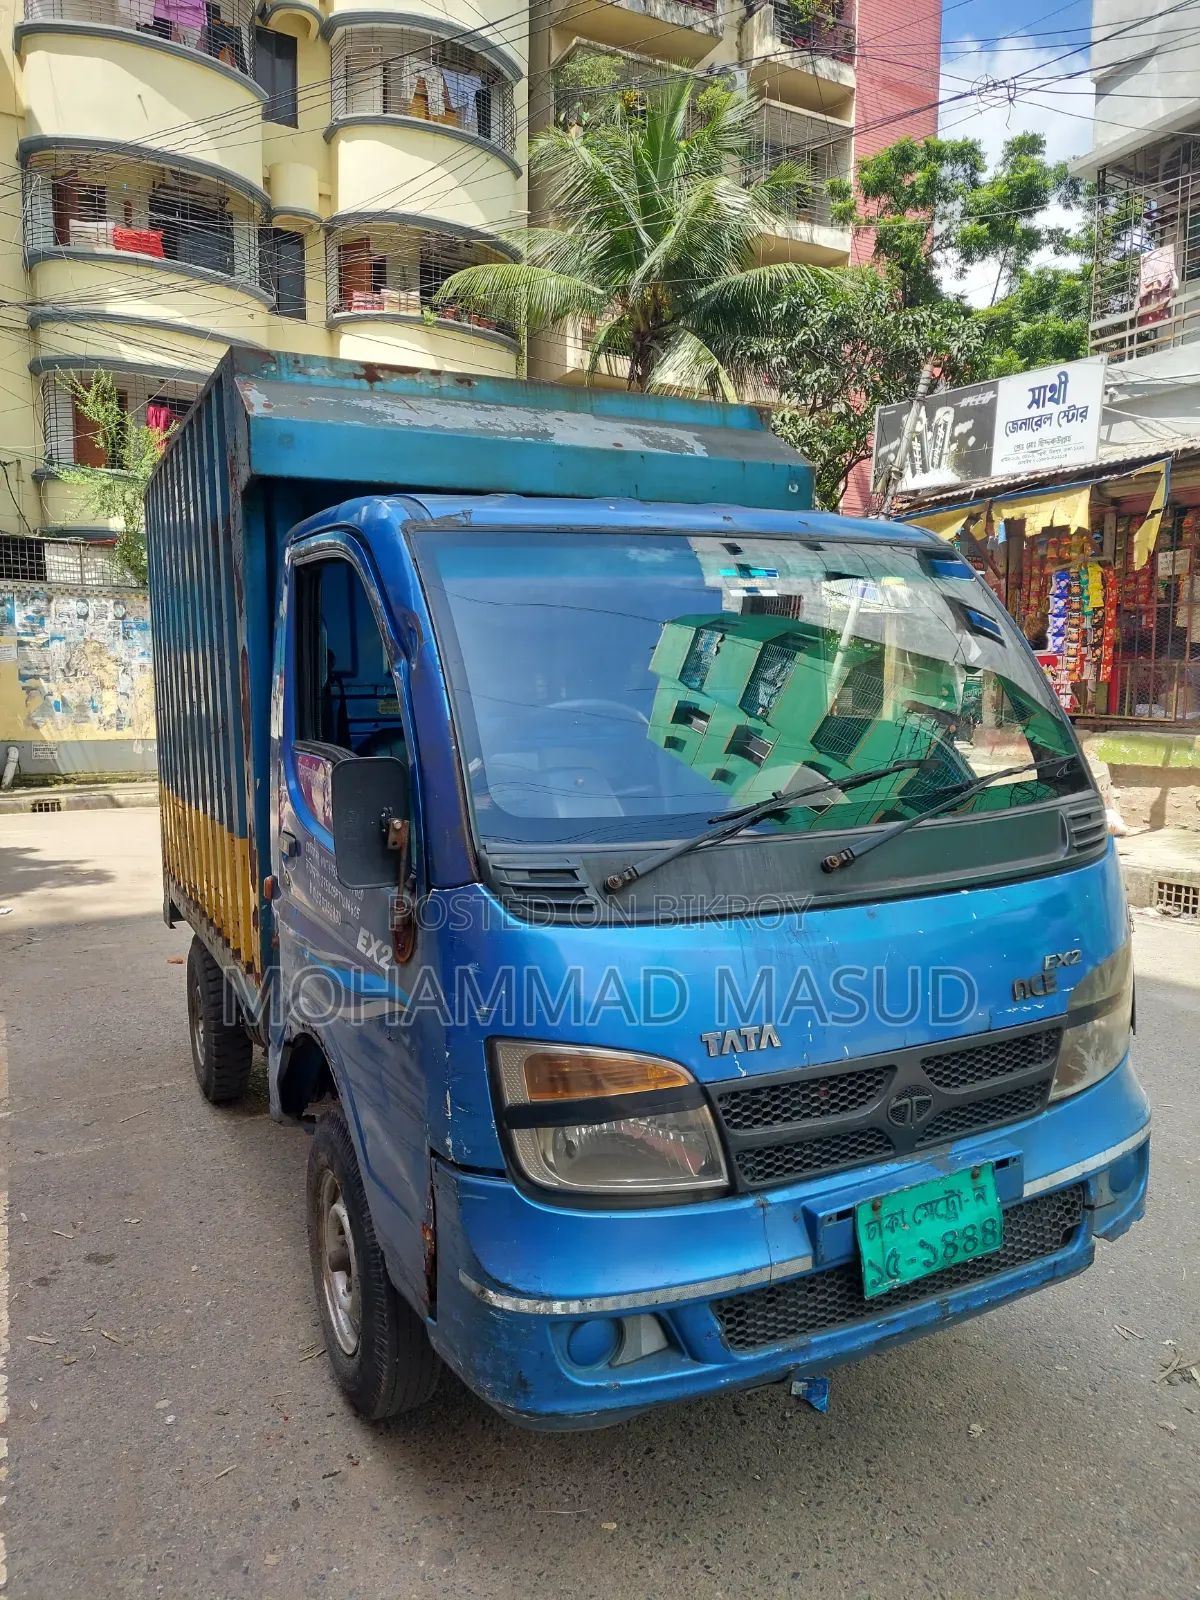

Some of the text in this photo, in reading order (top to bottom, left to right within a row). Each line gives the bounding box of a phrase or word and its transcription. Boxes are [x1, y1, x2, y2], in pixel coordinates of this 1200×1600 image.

[1027, 371, 1069, 409] সাথী
[1005, 404, 1089, 437] জেনারেল স্টোর
[356, 927, 393, 971] EX2
[1044, 949, 1082, 971] EX2
[1012, 972, 1058, 1001] ACE
[701, 1024, 781, 1057] TATA
[865, 1208, 906, 1240] ঢাকা
